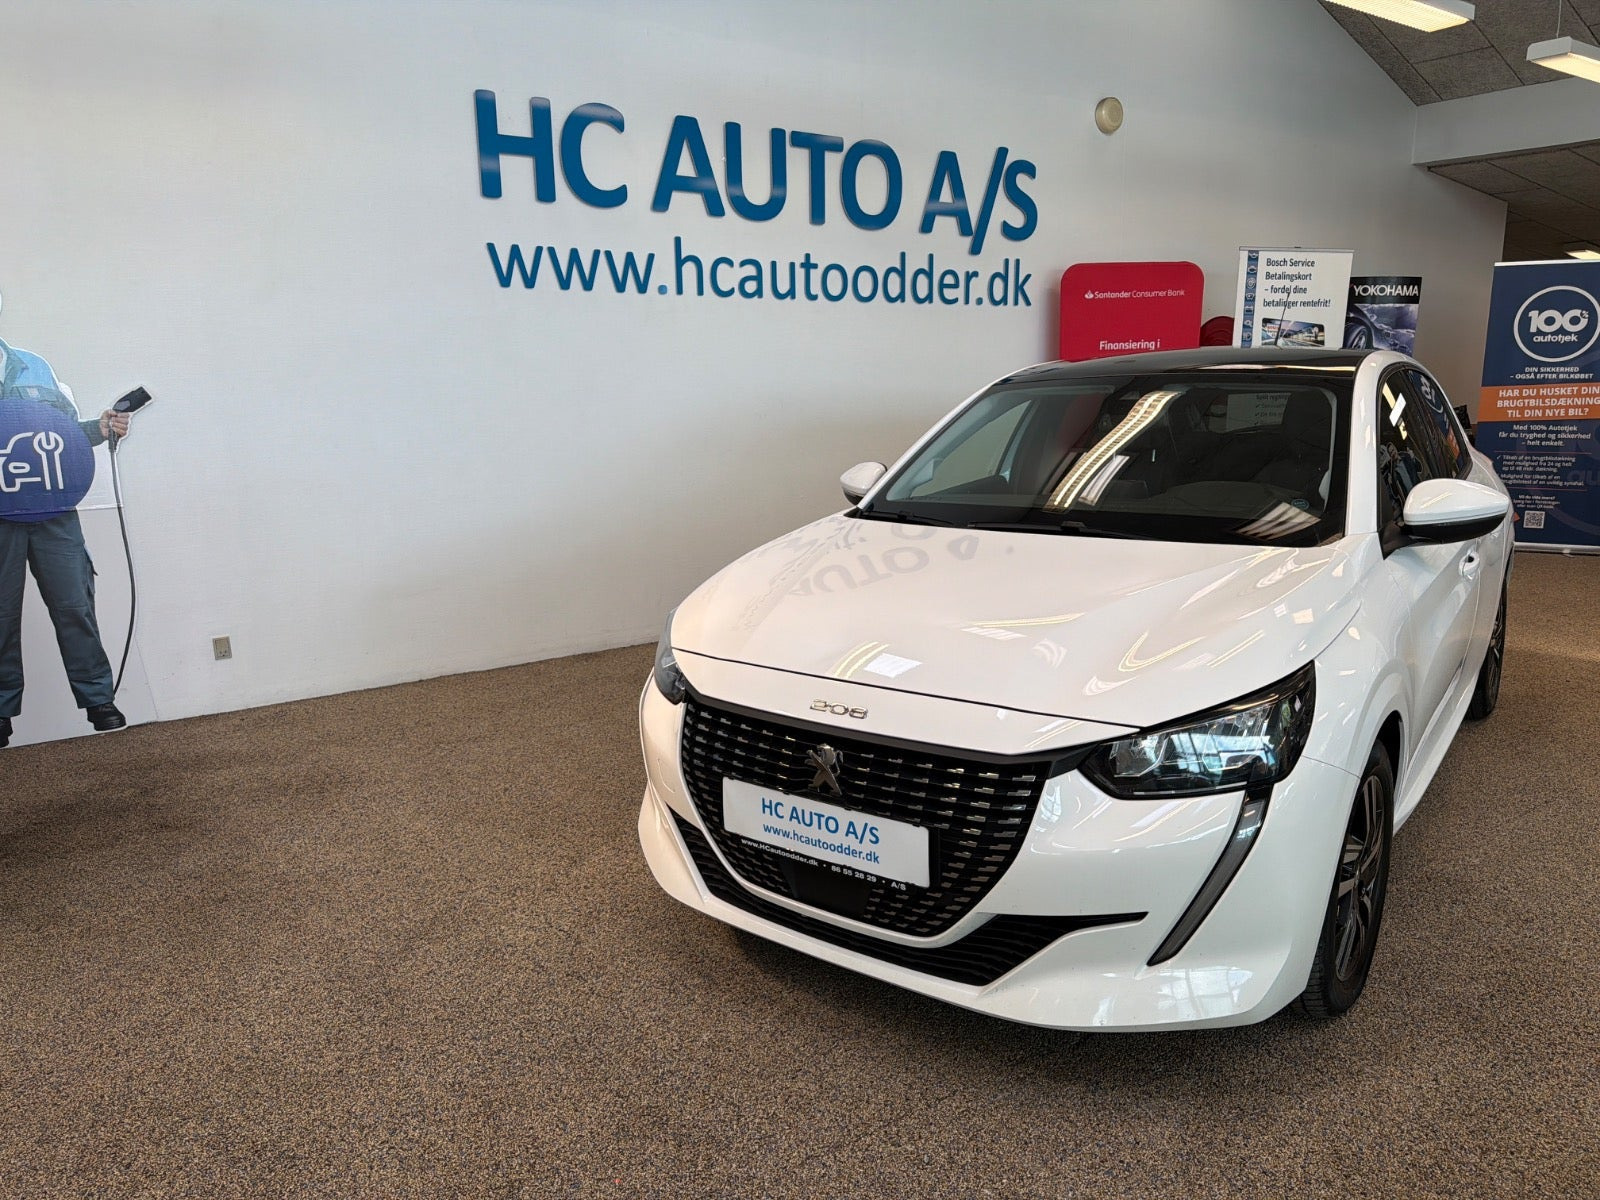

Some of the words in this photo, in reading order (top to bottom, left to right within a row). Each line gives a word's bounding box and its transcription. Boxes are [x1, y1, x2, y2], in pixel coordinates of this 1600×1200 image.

[474, 89, 628, 209] HC
[651, 115, 902, 231] AUTO
[920, 146, 1038, 255] A/S
[1266, 258, 1288, 267] Bosch
[1289, 258, 1316, 267] Service
[486, 236, 1032, 307] www.hcautoodder.dk
[1265, 271, 1312, 282] Betalingskort
[1094, 290, 1131, 299] Santander
[1132, 290, 1167, 298] Consumer
[1167, 289, 1185, 297] Bank
[1270, 285, 1292, 294] fordel
[1292, 285, 1308, 294] dine
[1353, 284, 1419, 297] YOKOHAMA
[1263, 298, 1299, 309] betalinger
[1299, 299, 1331, 308] rentefrit!
[1533, 334, 1578, 344] autotjek
[1099, 339, 1155, 351] Finansiering
[1157, 339, 1161, 348] i
[1499, 389, 1520, 397] HAR
[1522, 388, 1537, 397] DU
[1539, 387, 1579, 396] HUSKET
[1581, 386, 1600, 395] DIN
[1496, 397, 1600, 408] BRUGTBILSDÆKNING
[1507, 409, 1521, 418] TIL
[1524, 409, 1543, 417] DIN
[1545, 408, 1566, 417] NYE
[1568, 407, 1589, 416] BIL?
[1548, 424, 1578, 433] Autotjek
[1520, 432, 1546, 440] tryghed
[809, 698, 869, 720] 208
[761, 797, 785, 819] HC
[789, 806, 840, 834] AUTO
[845, 820, 880, 845] A/S
[763, 823, 880, 864] www.hcautoodder.dk
[741, 838, 819, 867] www.HCautoodder.dk
[890, 881, 907, 891] A/S
